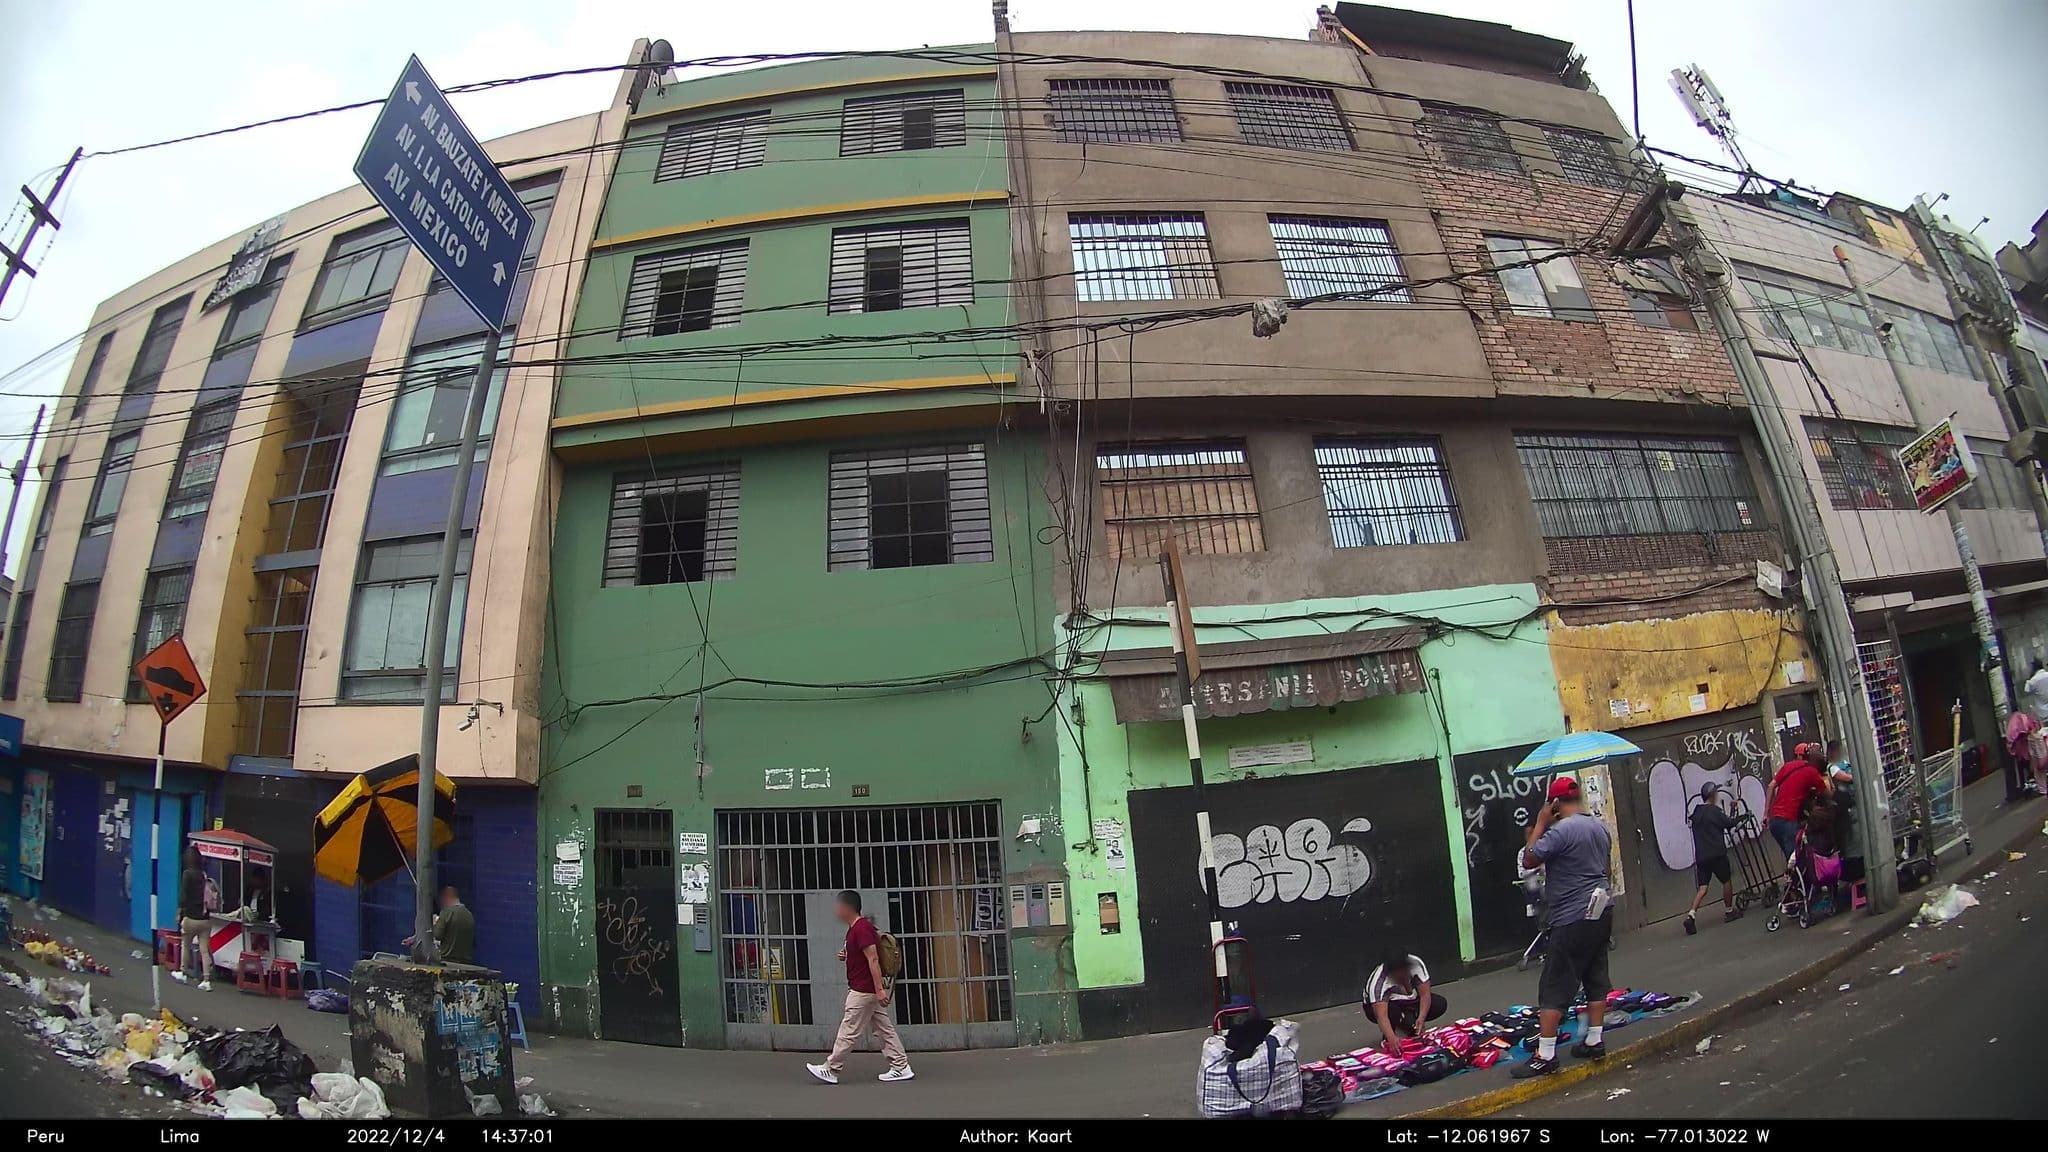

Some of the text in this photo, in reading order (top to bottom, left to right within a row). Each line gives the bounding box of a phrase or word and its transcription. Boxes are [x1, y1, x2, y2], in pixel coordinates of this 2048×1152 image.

[384, 162, 468, 268] AV. MEXICO
[395, 123, 417, 159] AV.
[422, 156, 440, 189] LA
[440, 178, 490, 251] CATOLICA
[420, 103, 519, 240] AV. BAUZATE Y MEZA
[1159, 673, 1320, 709] ATESANIA
